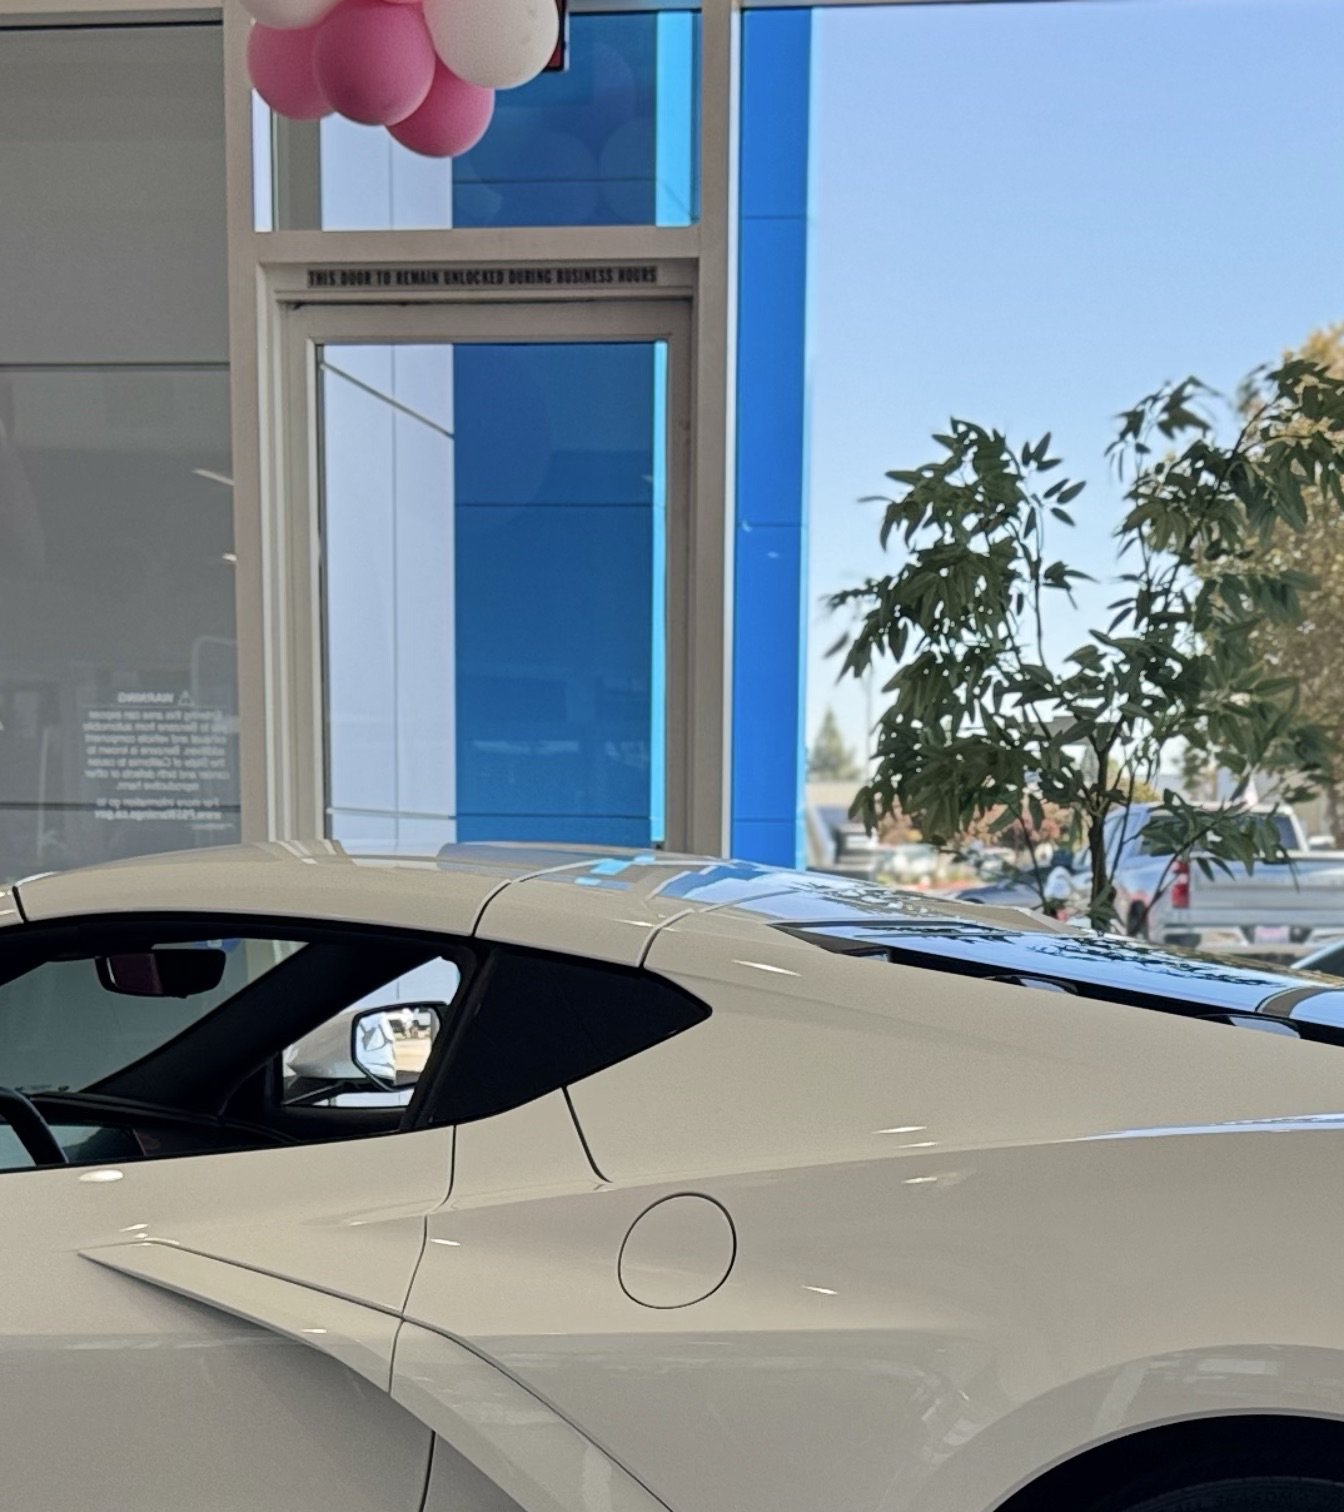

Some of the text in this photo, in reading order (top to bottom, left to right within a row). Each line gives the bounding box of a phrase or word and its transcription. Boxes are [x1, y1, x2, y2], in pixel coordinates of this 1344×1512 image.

[309, 267, 656, 286] THIS DOOR TO REMAIN UNLOCKED DURING BUSINESS HOURS
